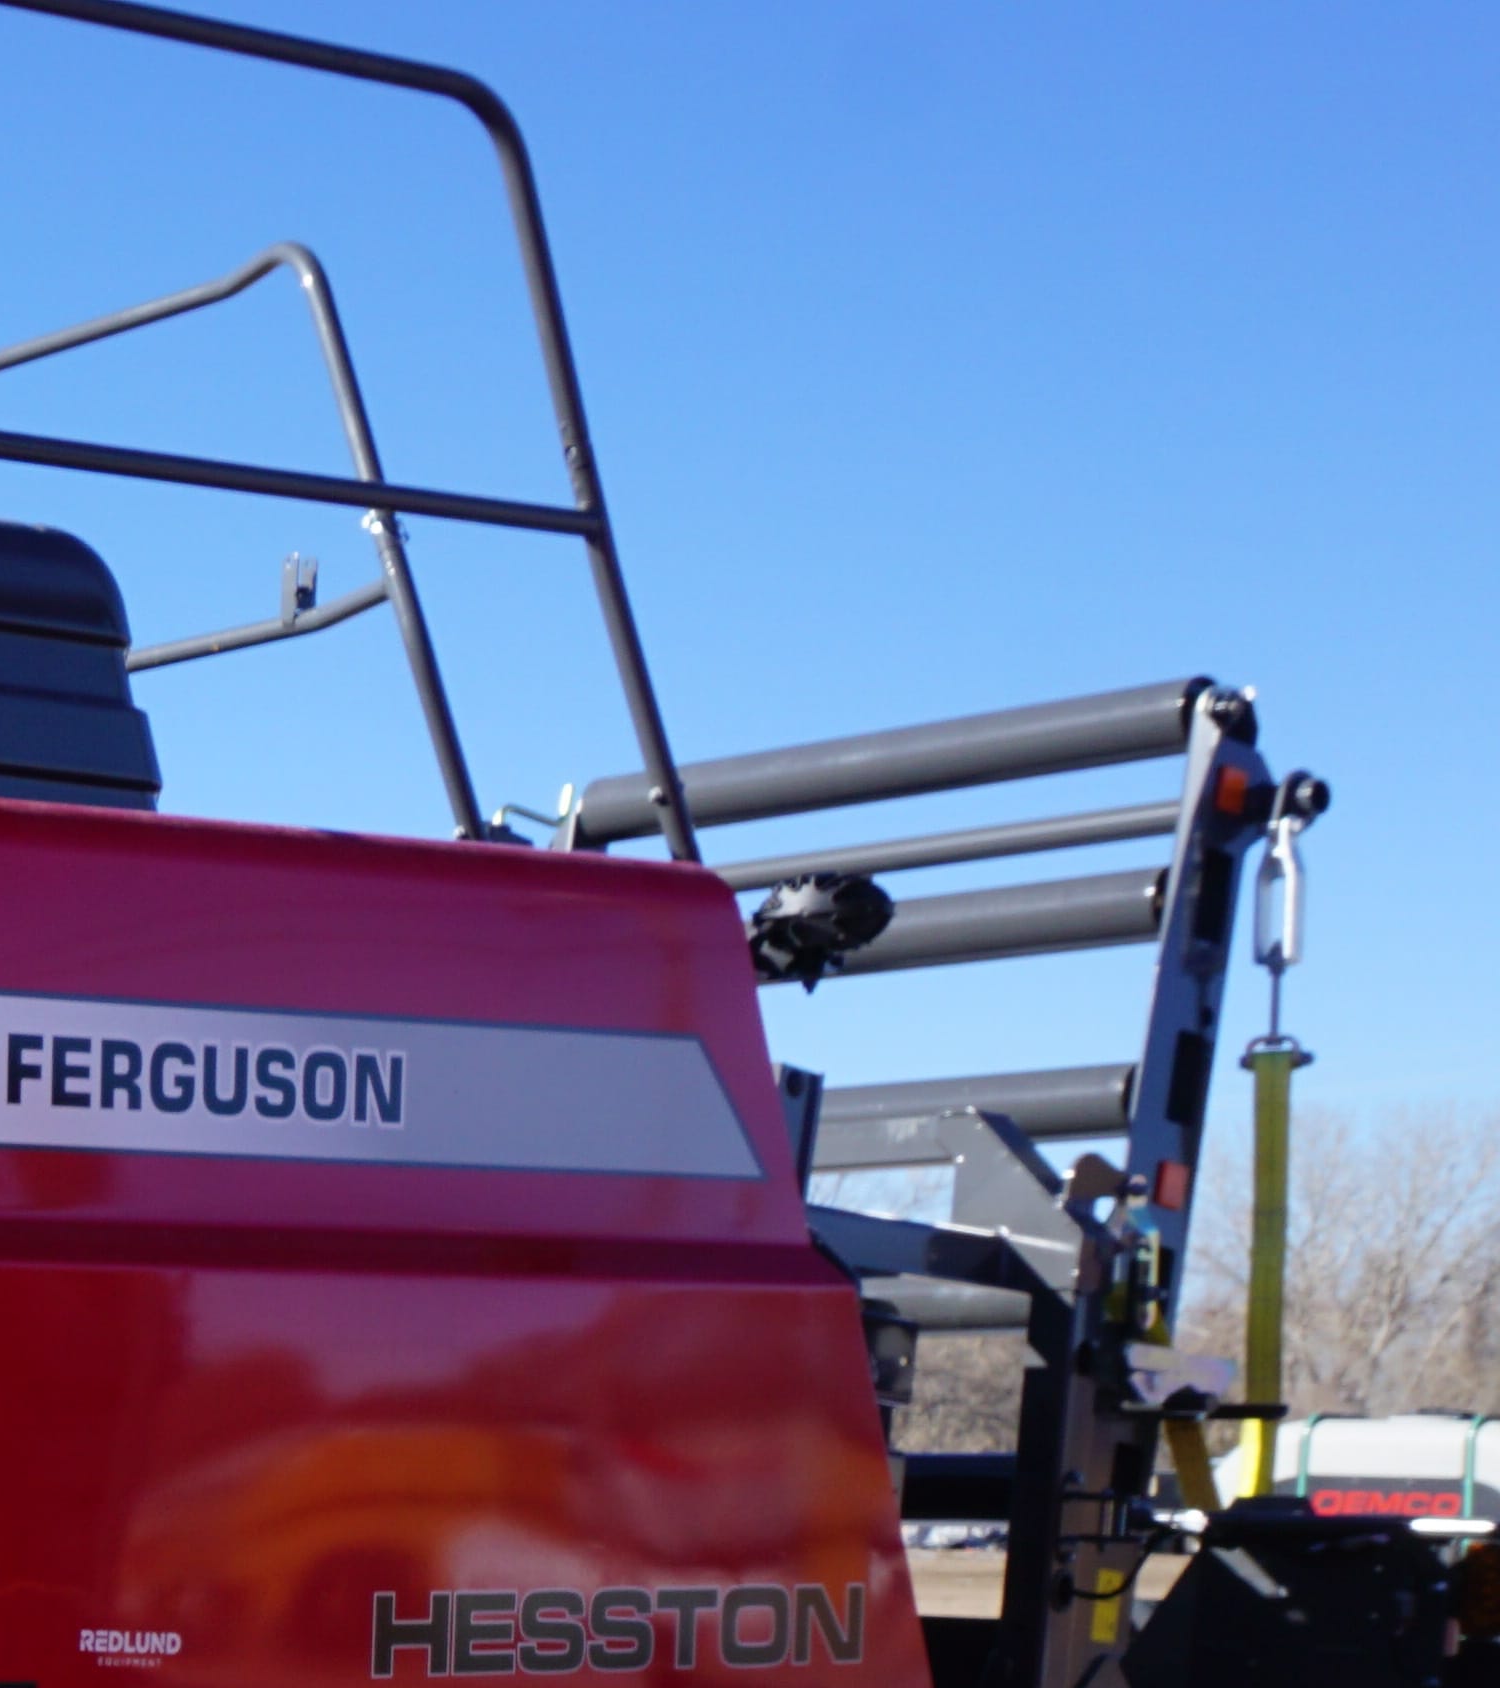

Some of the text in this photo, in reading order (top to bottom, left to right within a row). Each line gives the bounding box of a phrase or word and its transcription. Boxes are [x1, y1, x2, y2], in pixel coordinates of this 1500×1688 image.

[6, 1033, 407, 1126] FERGUSON
[79, 1629, 182, 1655] REDLUND
[370, 1582, 865, 1678] HESSTON
